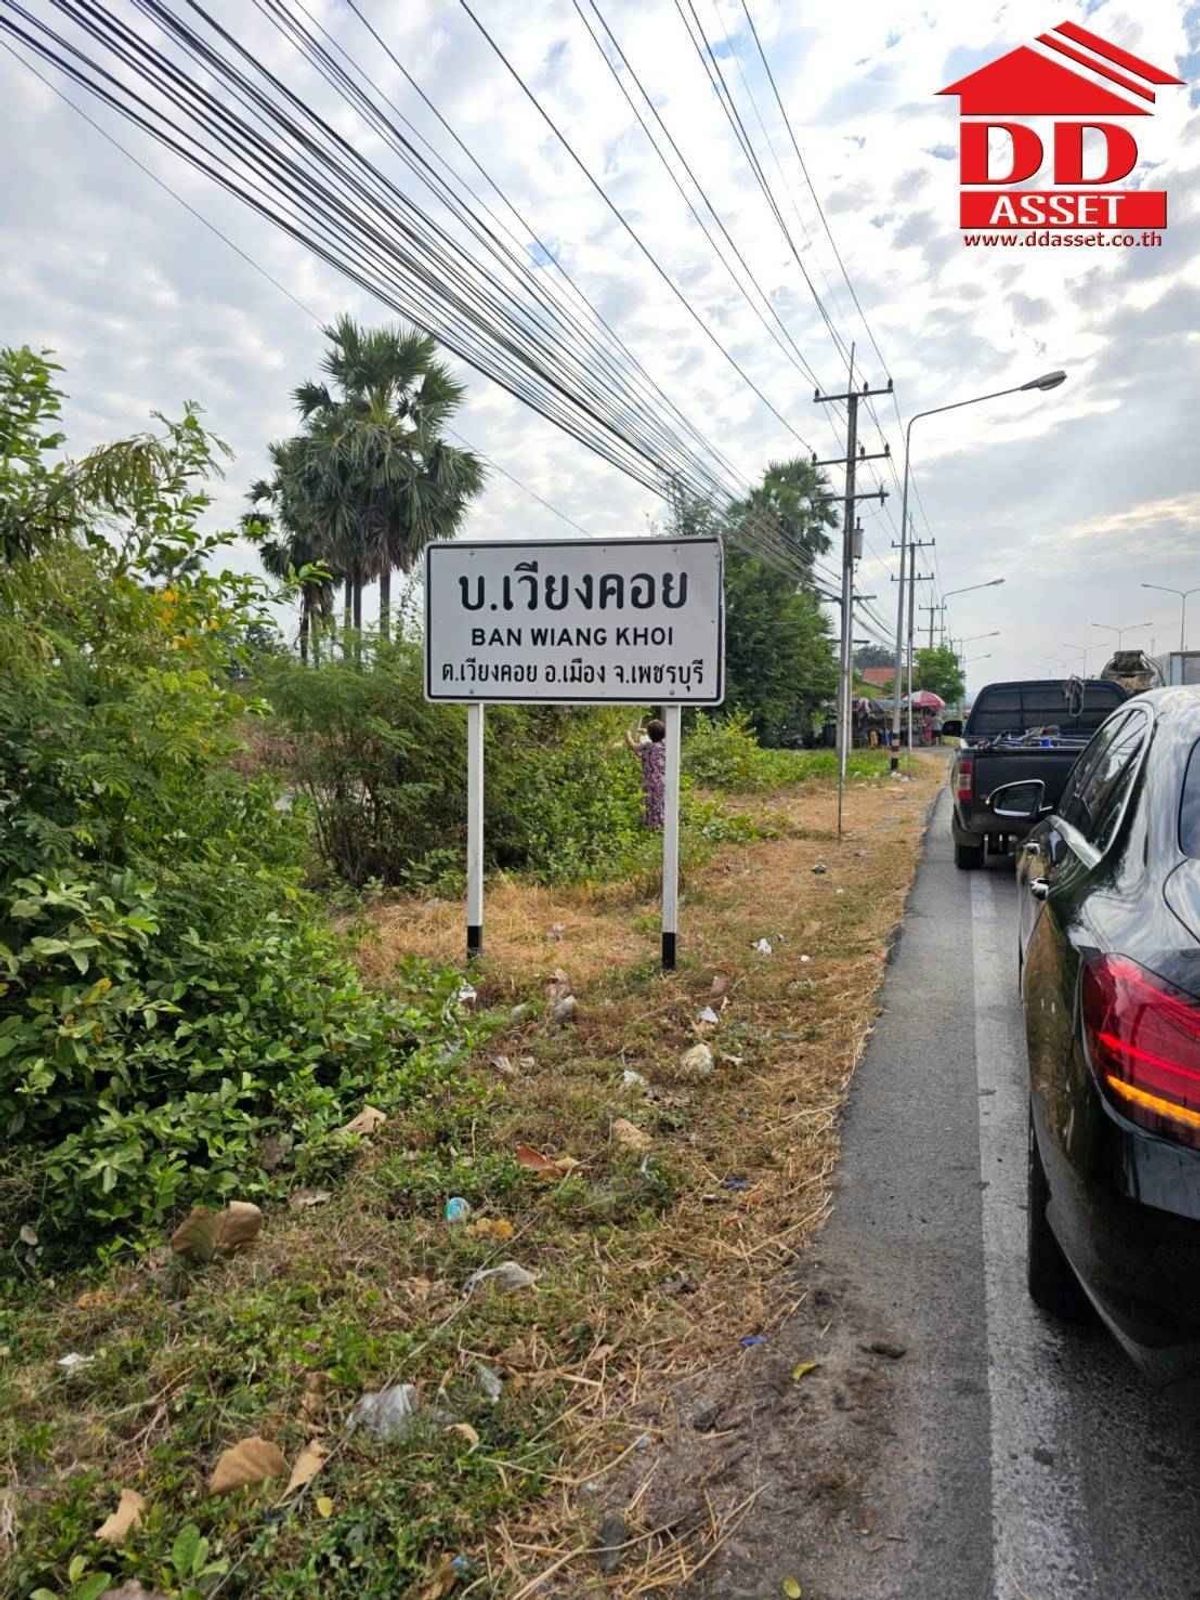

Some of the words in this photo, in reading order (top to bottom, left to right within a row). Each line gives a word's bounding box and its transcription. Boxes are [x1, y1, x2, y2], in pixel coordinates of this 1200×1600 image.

[459, 560, 688, 611] บ.เวียงคอย
[471, 628, 522, 646] BAN
[531, 627, 607, 646] WIANG
[615, 626, 673, 646] KHOI
[442, 657, 537, 683] ต.เวียงคอย
[545, 658, 605, 684] อ.เมือง
[615, 659, 704, 692] จ.เพชรบุรี
